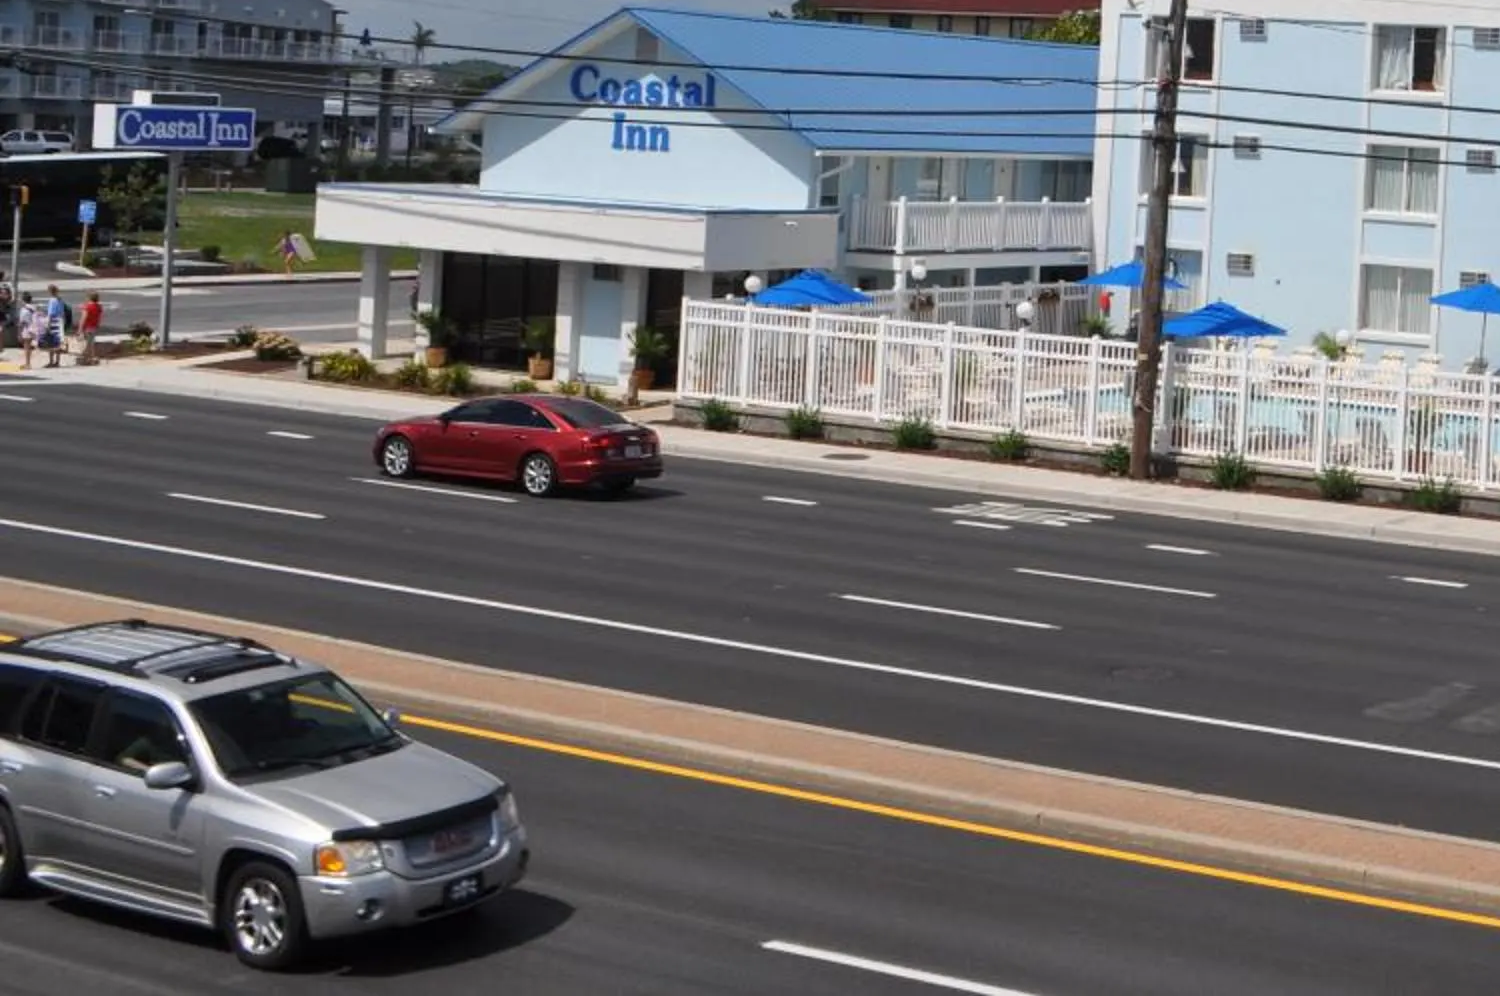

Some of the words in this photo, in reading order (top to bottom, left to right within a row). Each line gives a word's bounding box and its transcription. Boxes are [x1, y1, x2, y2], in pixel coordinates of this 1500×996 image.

[571, 63, 716, 107] Coastal
[118, 109, 206, 145] Coastal
[207, 112, 248, 146] Inn
[611, 111, 670, 152] Inn
